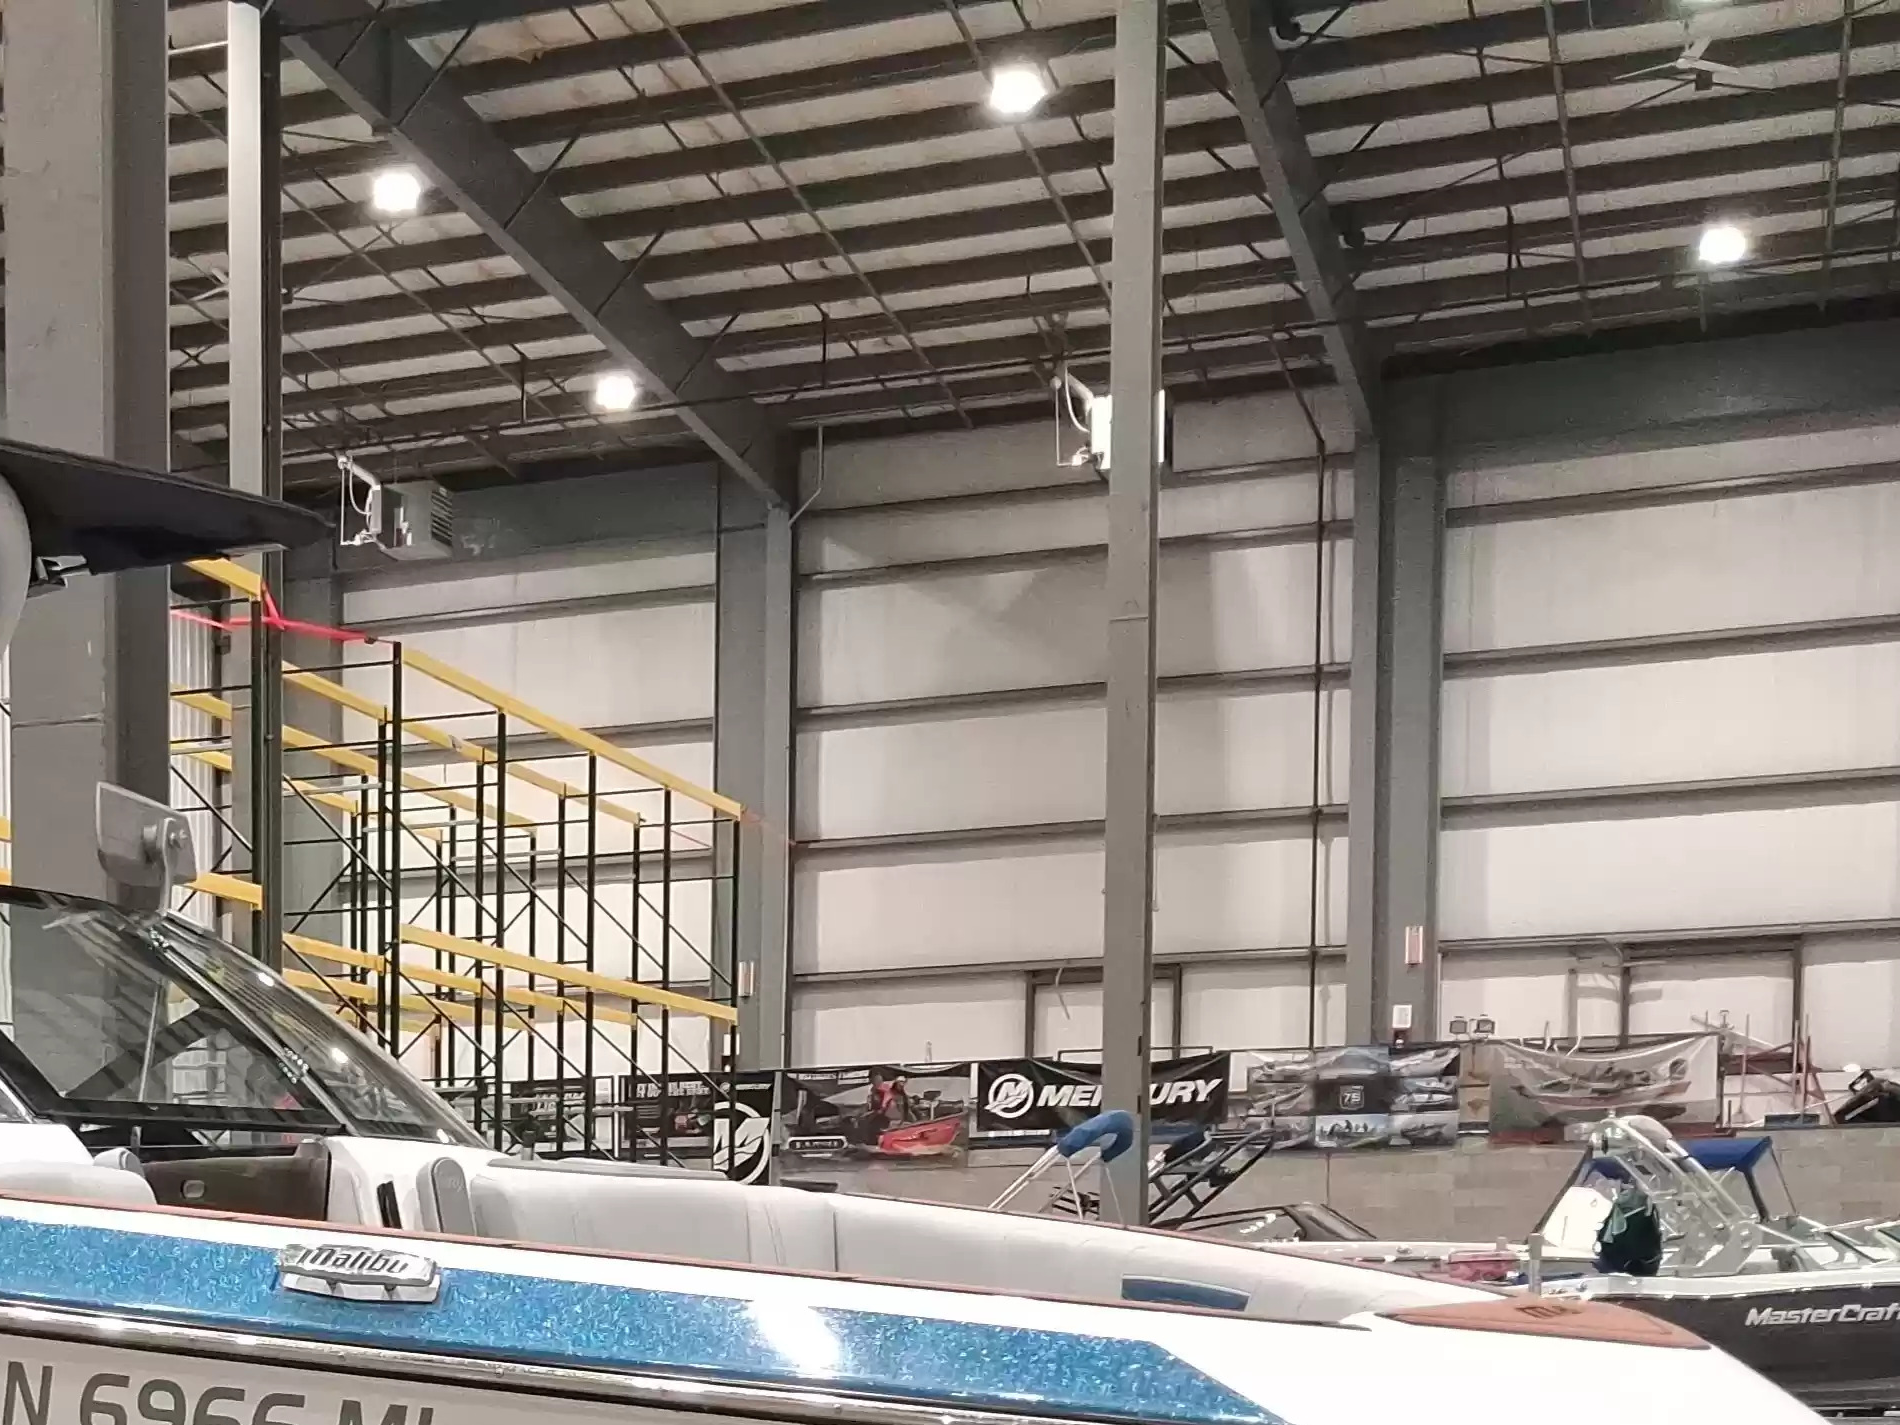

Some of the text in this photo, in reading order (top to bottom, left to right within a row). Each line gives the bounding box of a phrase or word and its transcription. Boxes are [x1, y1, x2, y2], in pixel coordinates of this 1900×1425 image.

[1036, 1078, 1223, 1107] MEURY
[296, 1248, 409, 1274] Malibu
[1745, 1303, 1900, 1327] MasterCraf
